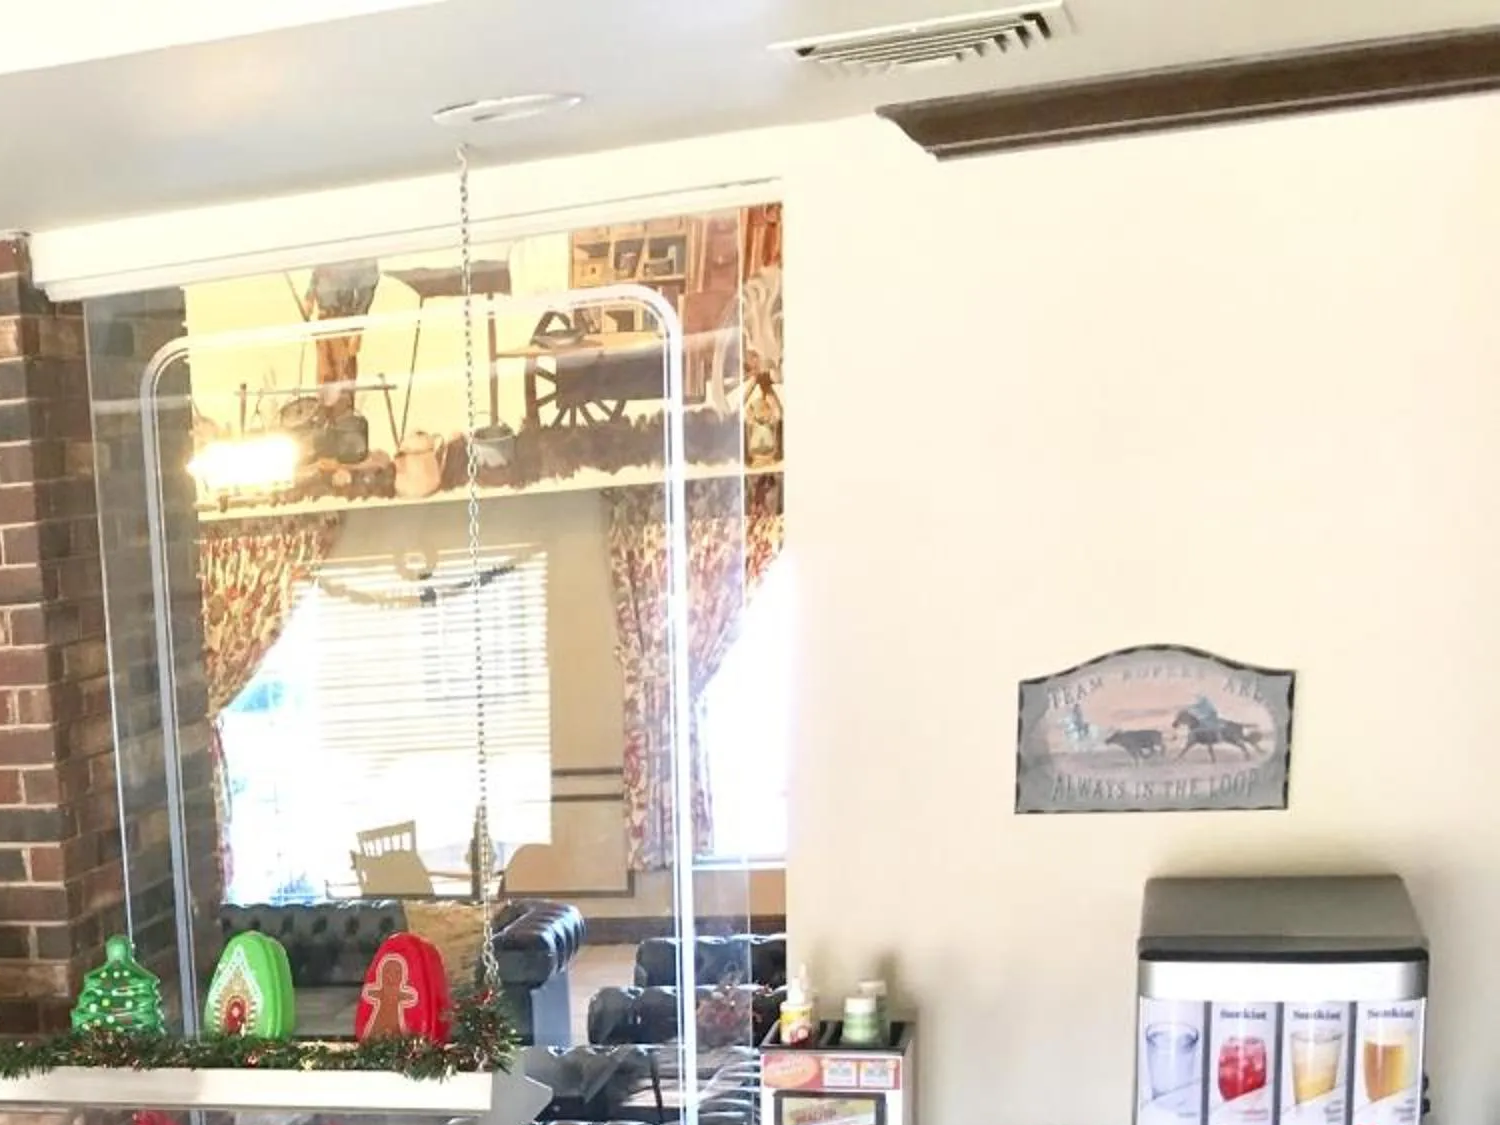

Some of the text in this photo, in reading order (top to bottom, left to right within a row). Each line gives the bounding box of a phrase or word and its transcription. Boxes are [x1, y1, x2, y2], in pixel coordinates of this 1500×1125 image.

[1051, 773, 1125, 801] ALWAYS
[1164, 776, 1199, 799] THE
[1207, 766, 1262, 799] LOOP
